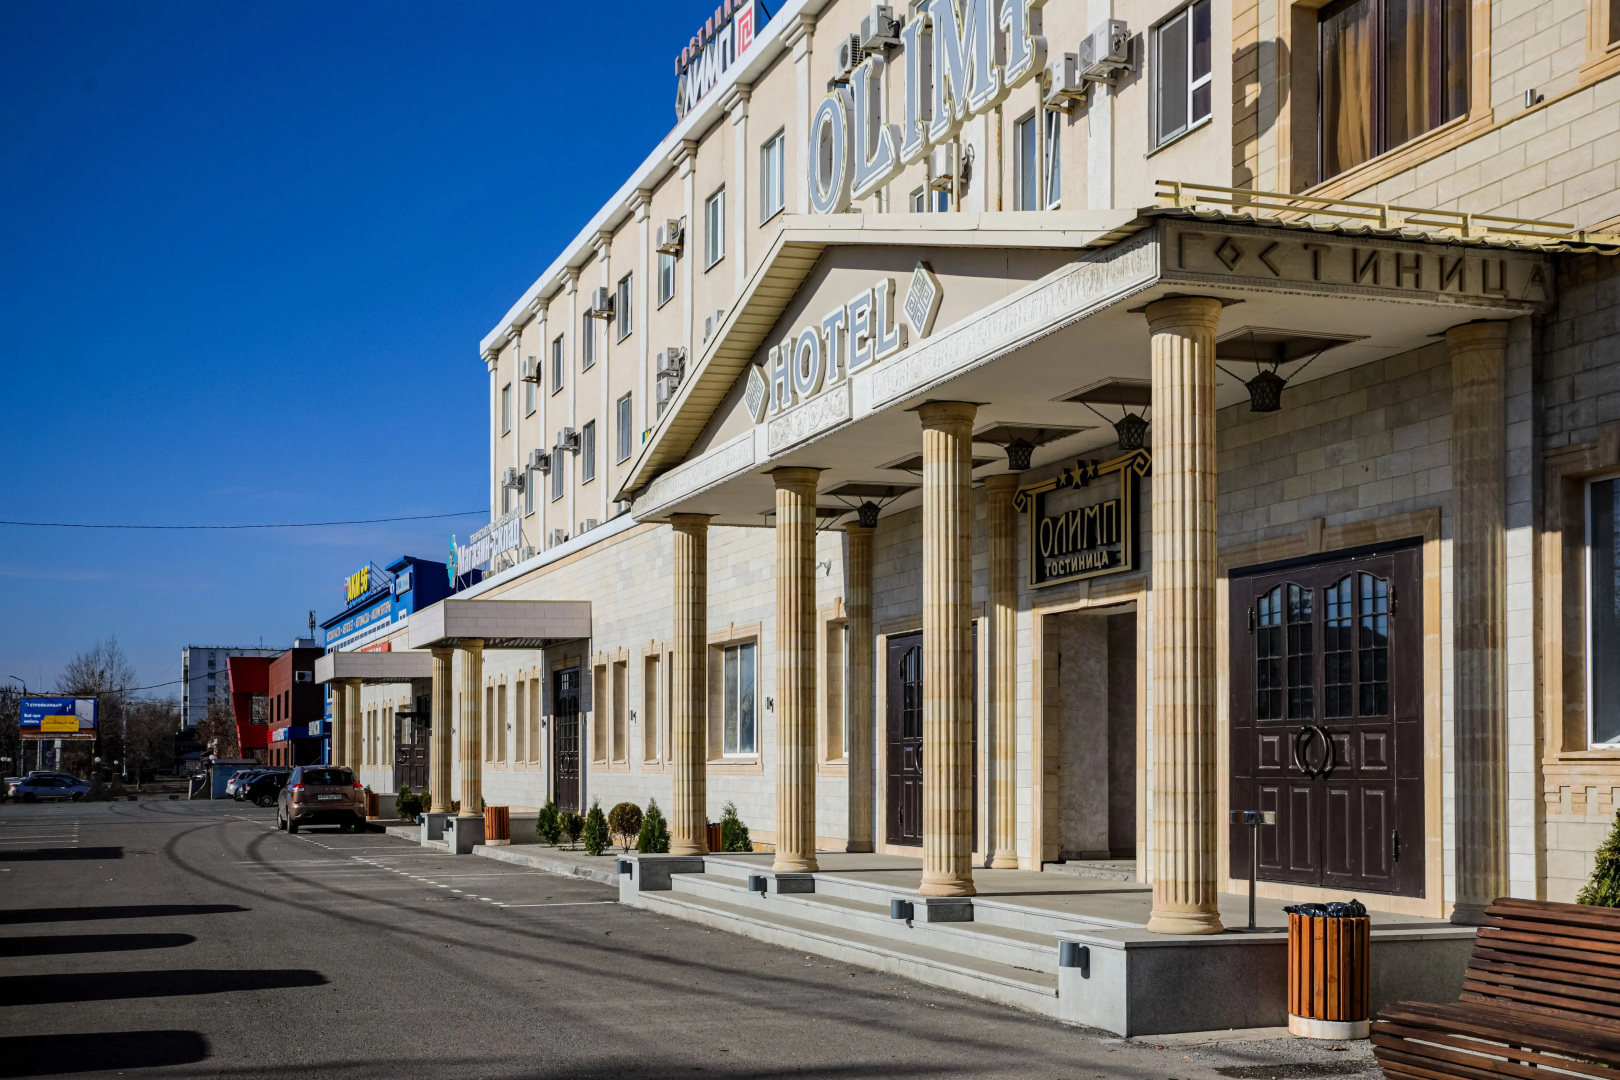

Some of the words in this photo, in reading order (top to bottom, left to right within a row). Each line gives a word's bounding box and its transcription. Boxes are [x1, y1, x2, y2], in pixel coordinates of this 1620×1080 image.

[675, 0, 744, 76] ГОСТИНИ
[1178, 231, 1551, 301] ГОСТИНИЦА
[768, 277, 908, 416] HOTEL
[457, 517, 521, 576] Магазин-склад
[1040, 500, 1117, 558] ОЛИМП
[1045, 550, 1109, 577] ГОСТИНИЦА
